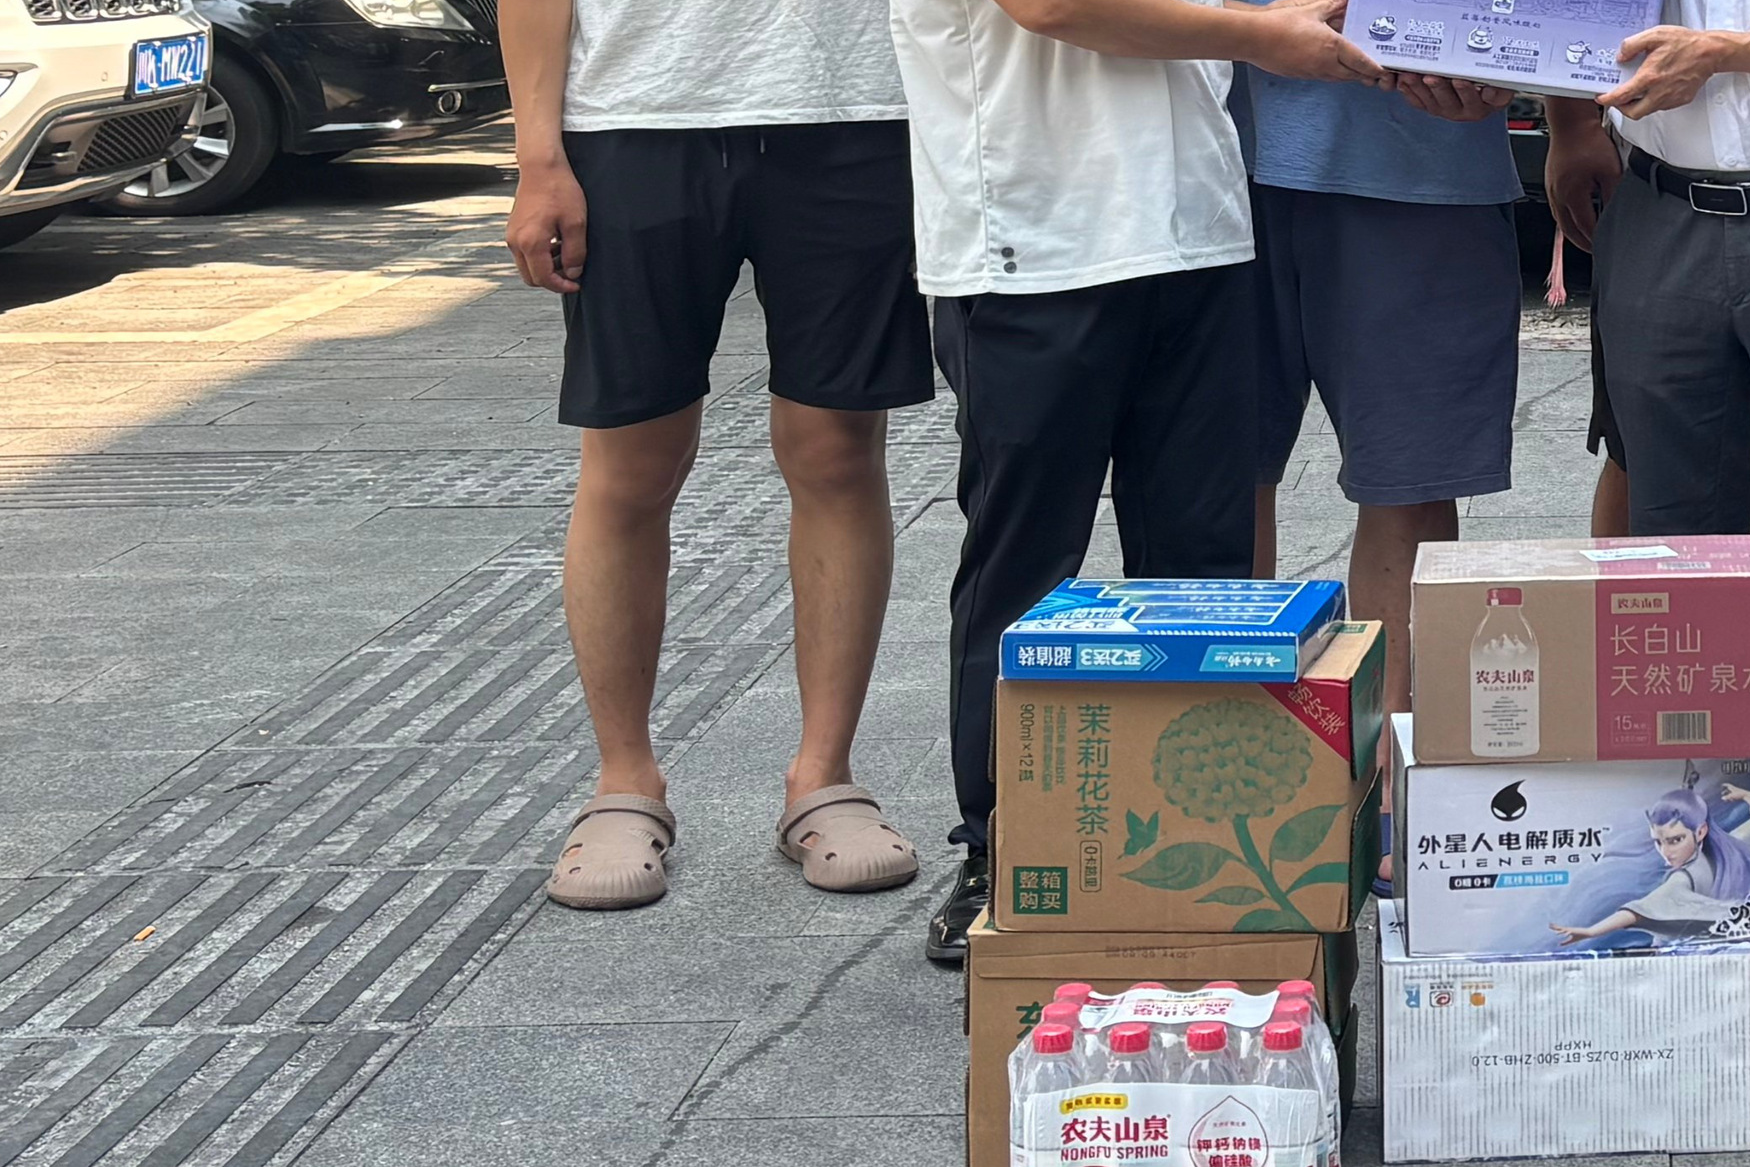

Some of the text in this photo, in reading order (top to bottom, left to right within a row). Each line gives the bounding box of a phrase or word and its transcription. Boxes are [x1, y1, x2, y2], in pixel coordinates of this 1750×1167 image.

[1616, 597, 1664, 609] 农夫山泉
[1609, 622, 1702, 657] 长白山
[1018, 646, 1142, 668] 买2送3 超值装
[1475, 668, 1535, 685] 农夫山泉
[1287, 684, 1347, 736] 畅饮装
[1614, 715, 1632, 730] 15
[1075, 702, 1112, 835] 茉莉花茶
[1418, 827, 1603, 854] 外星人电解质水
[1418, 853, 1602, 870] ALIENERGY
[1019, 870, 1062, 890] 整箱
[1019, 891, 1061, 910] 购买
[1554, 1040, 1592, 1051] HXPP
[1060, 1115, 1169, 1144] 农夫山泉
[1060, 1144, 1169, 1162] NONGFU SPRING
[1196, 1136, 1262, 1152] 钾钙钠镁
